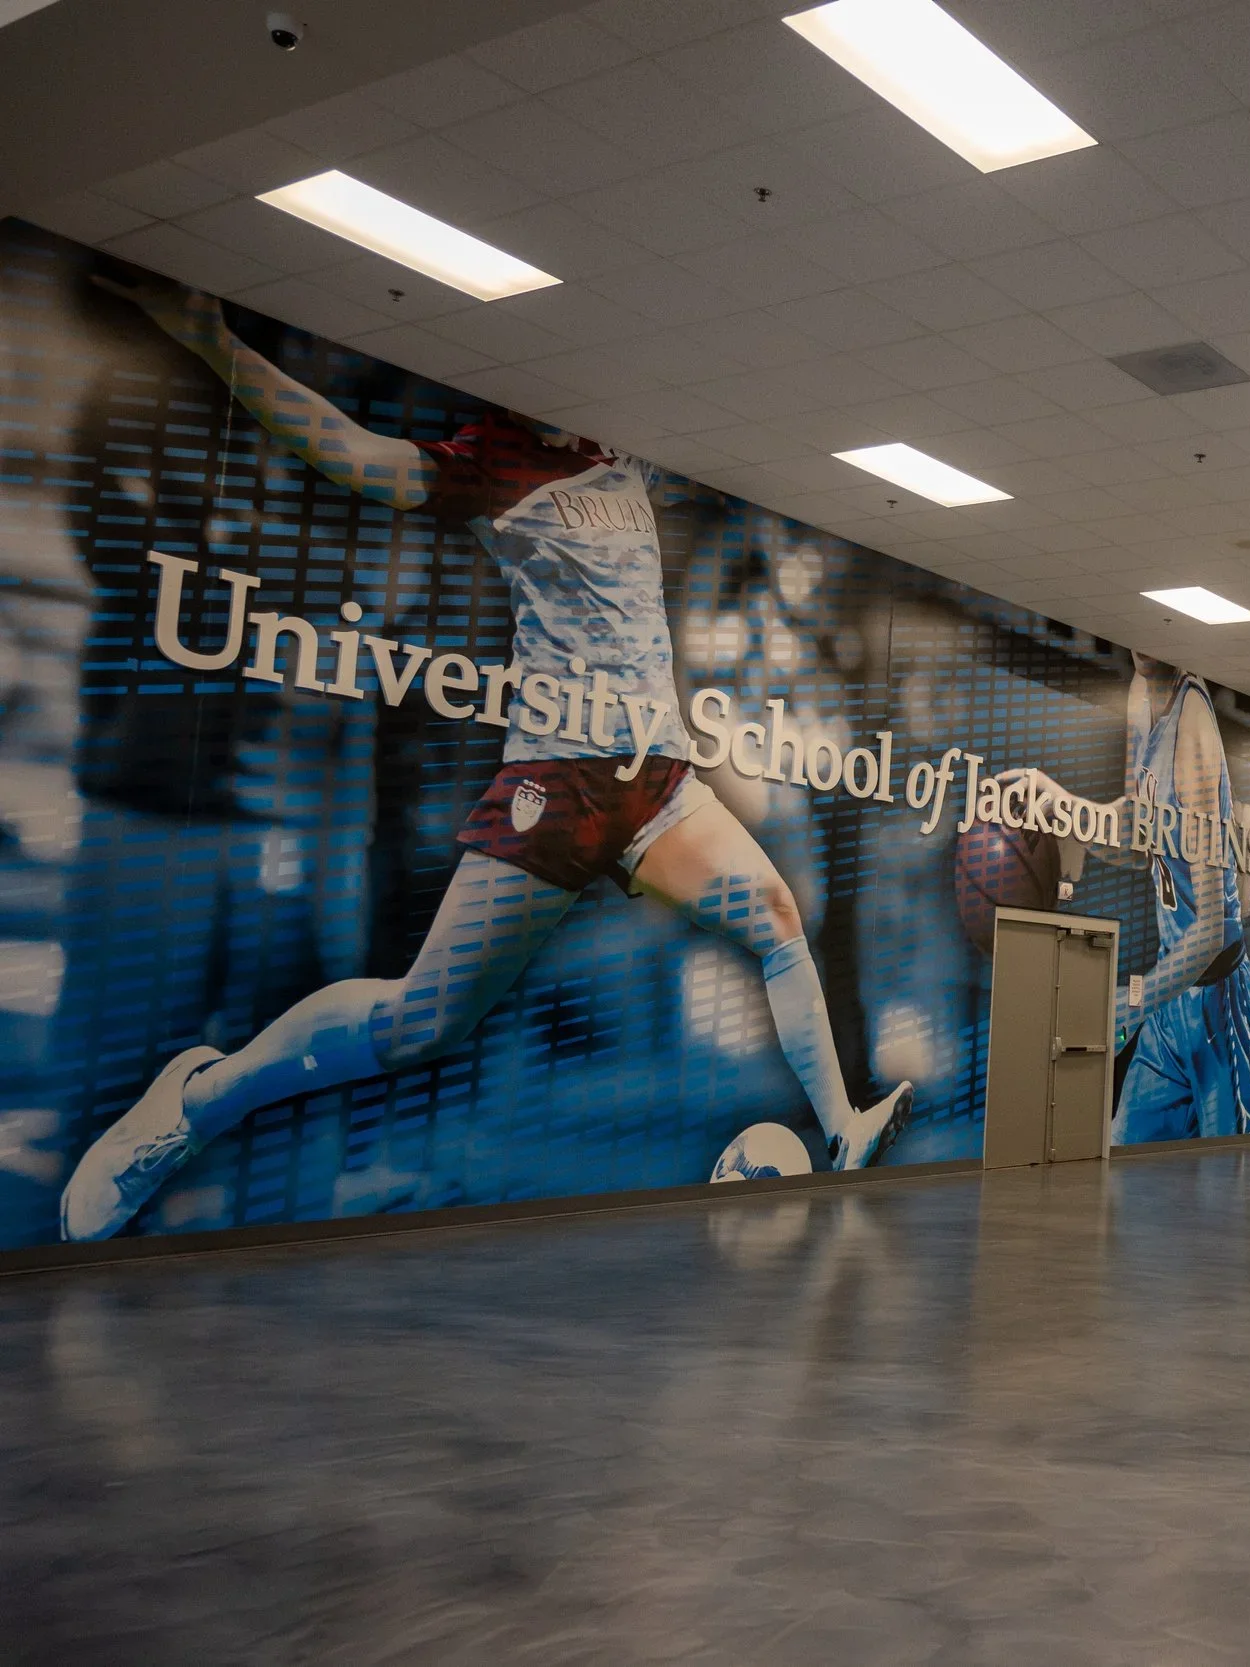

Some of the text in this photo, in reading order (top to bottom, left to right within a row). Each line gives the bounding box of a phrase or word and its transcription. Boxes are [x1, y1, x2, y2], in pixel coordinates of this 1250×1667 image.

[147, 550, 671, 782] University
[687, 688, 894, 803] School
[906, 747, 961, 835] of
[957, 753, 1120, 849] Jackson
